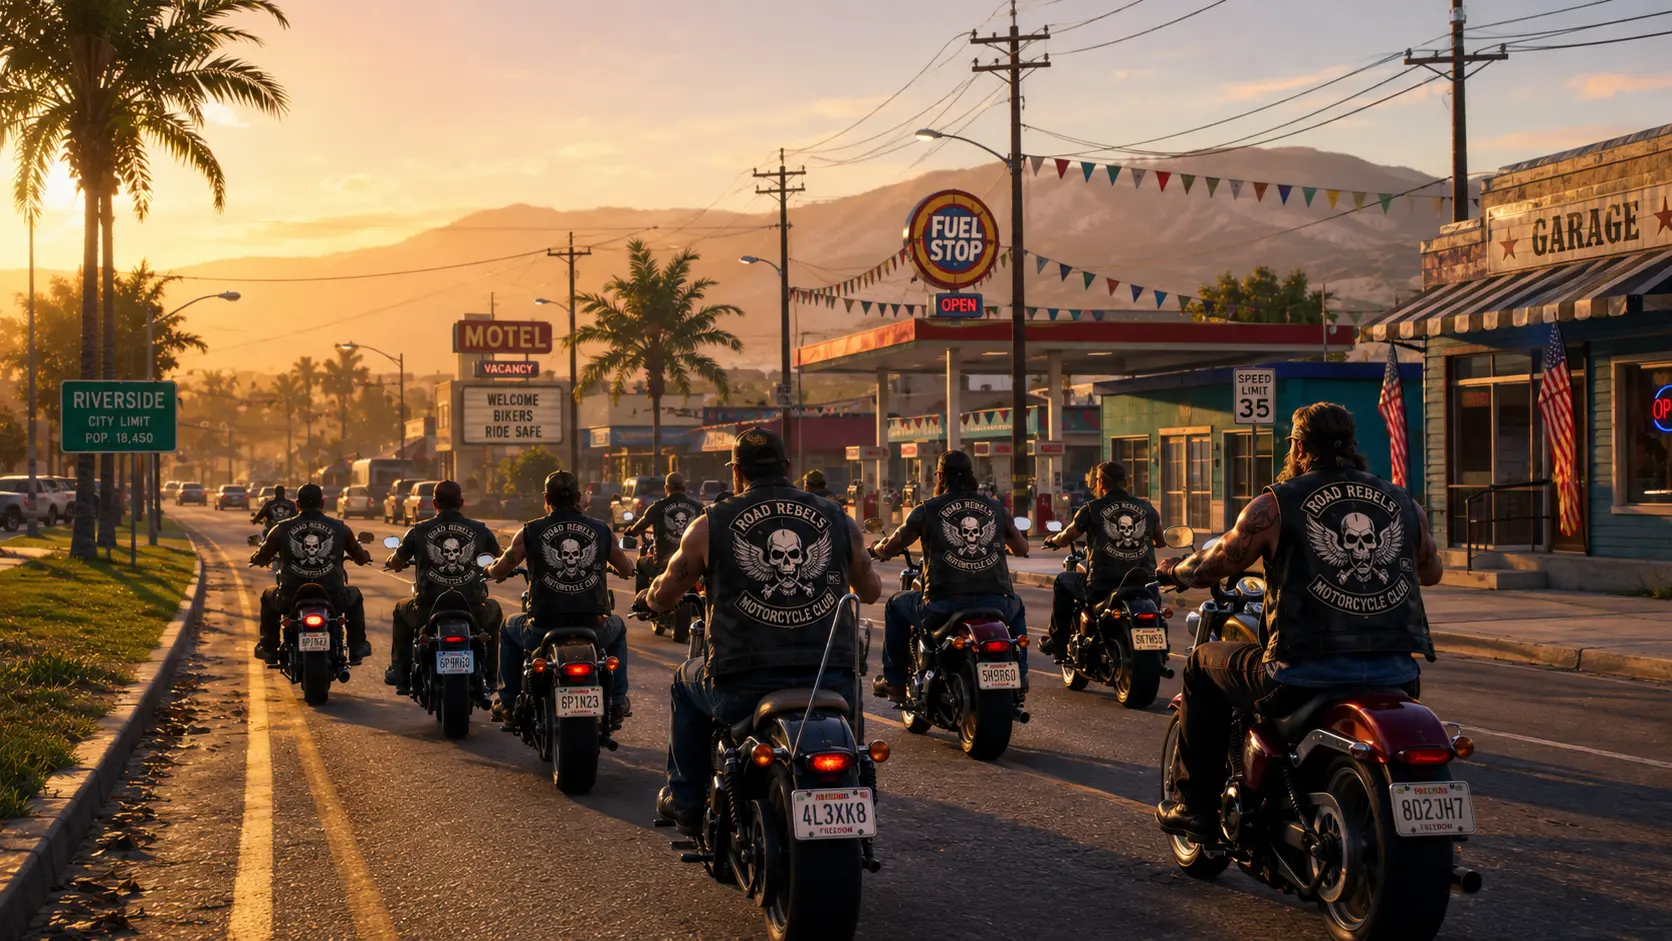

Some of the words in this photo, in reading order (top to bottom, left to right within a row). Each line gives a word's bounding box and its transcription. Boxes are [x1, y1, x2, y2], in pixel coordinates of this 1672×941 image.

[931, 215, 983, 239] FUEL
[1531, 200, 1640, 257] GARAGE
[930, 239, 984, 262] STOP
[941, 297, 977, 312] OPEN
[465, 324, 547, 348] MOTEL
[484, 363, 534, 374] VACANCY
[1238, 374, 1272, 384] SPEED
[73, 391, 165, 409] RIVERSIDE
[487, 393, 539, 406] WELCOME
[1241, 386, 1269, 395] LIMIT
[493, 409, 533, 422] BIKERS
[1240, 398, 1270, 418] 35
[88, 415, 115, 427] CITY
[120, 415, 151, 427] LIMIT
[85, 432, 111, 444] POP.
[115, 432, 154, 445] 18,450
[485, 425, 510, 438] RIDE
[515, 425, 542, 438] SAFE
[1306, 486, 1342, 513] ROAD
[1346, 485, 1397, 513] REBELS
[735, 504, 771, 531] ROAD
[776, 502, 827, 529] REBELS
[1313, 581, 1387, 612] MOTORCYCLE
[1386, 579, 1409, 605] CLUB
[739, 595, 812, 624] MOTORCYCLE
[812, 592, 835, 617] CLUB
[561, 695, 599, 709] 6P1N23
[802, 802, 867, 826] 4L3XK8
[1401, 797, 1463, 821] 8D2JH7
